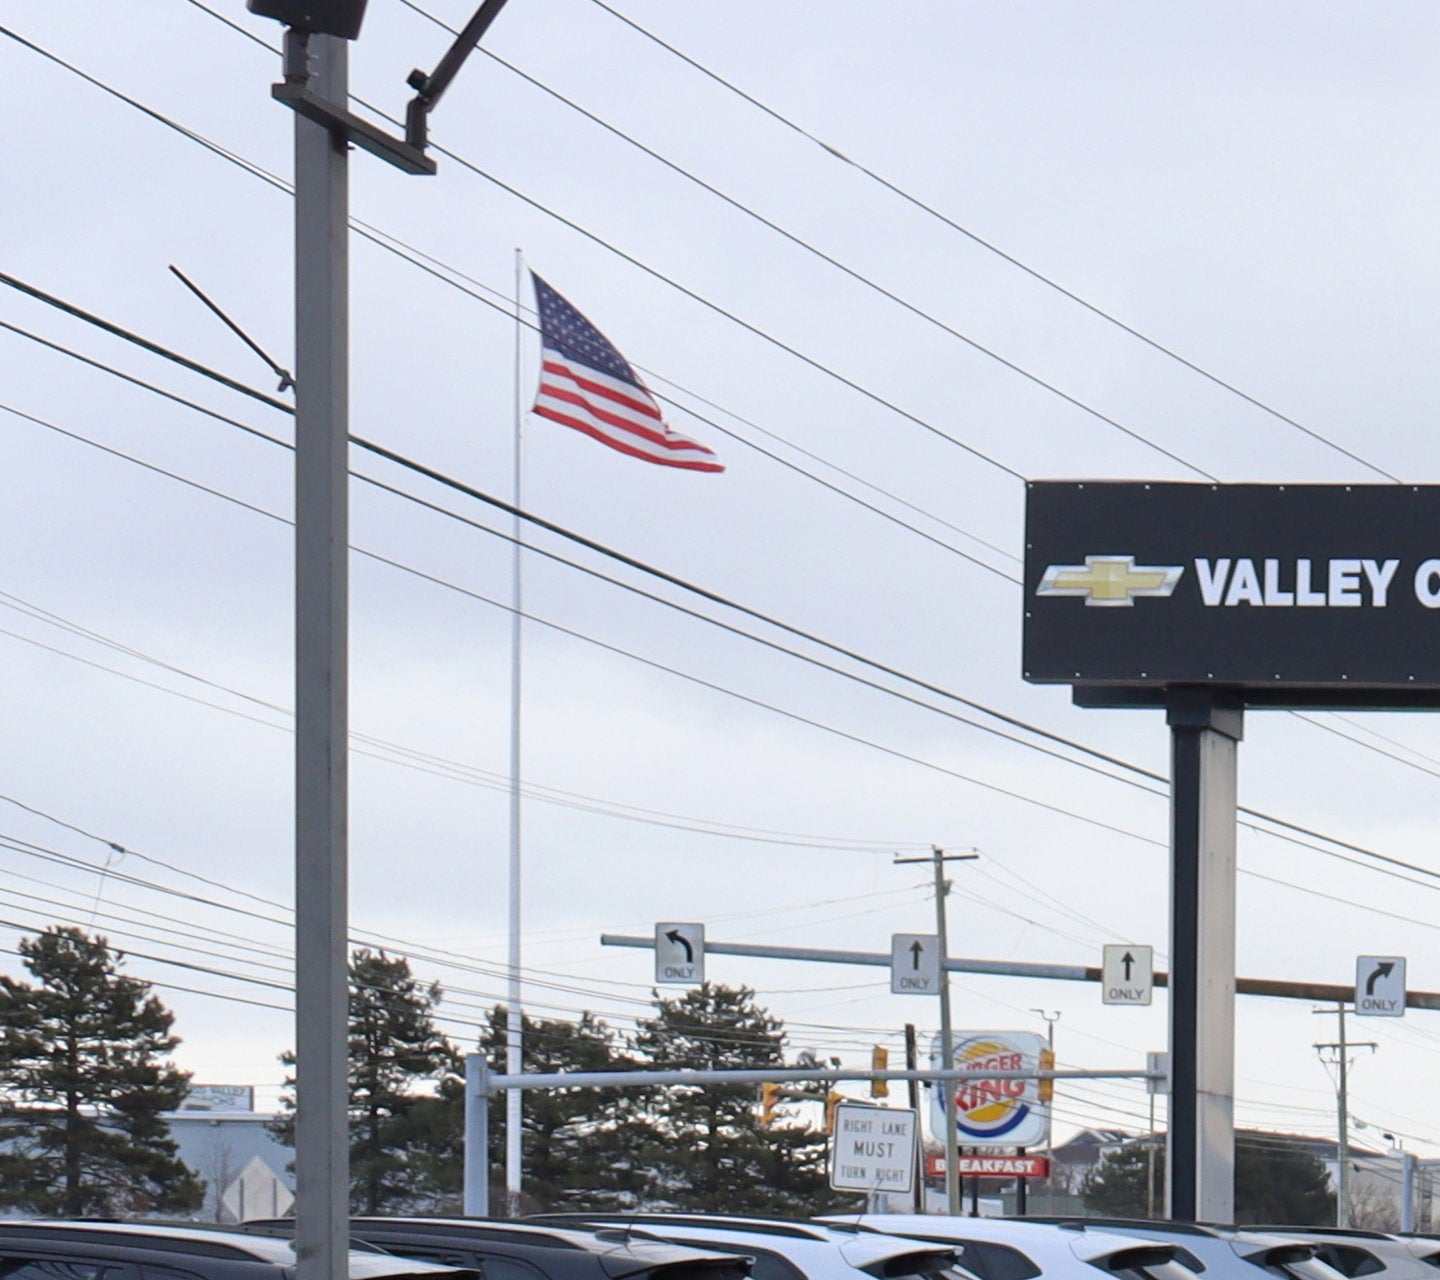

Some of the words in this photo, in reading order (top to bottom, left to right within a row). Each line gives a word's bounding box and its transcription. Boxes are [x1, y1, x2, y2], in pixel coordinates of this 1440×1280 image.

[1194, 557, 1400, 608] VALLEY
[664, 966, 695, 979] ONLY
[900, 977, 931, 990] ONLY
[1108, 988, 1145, 1000] ONLY
[1361, 999, 1398, 1011] ONLY
[843, 1119, 873, 1134] RIGHT
[881, 1122, 908, 1137] LANE
[853, 1140, 895, 1159] MUST
[840, 1164, 867, 1179] TURN
[875, 1166, 905, 1182] RIGHT
[934, 1157, 1035, 1174] BEAKFAST
